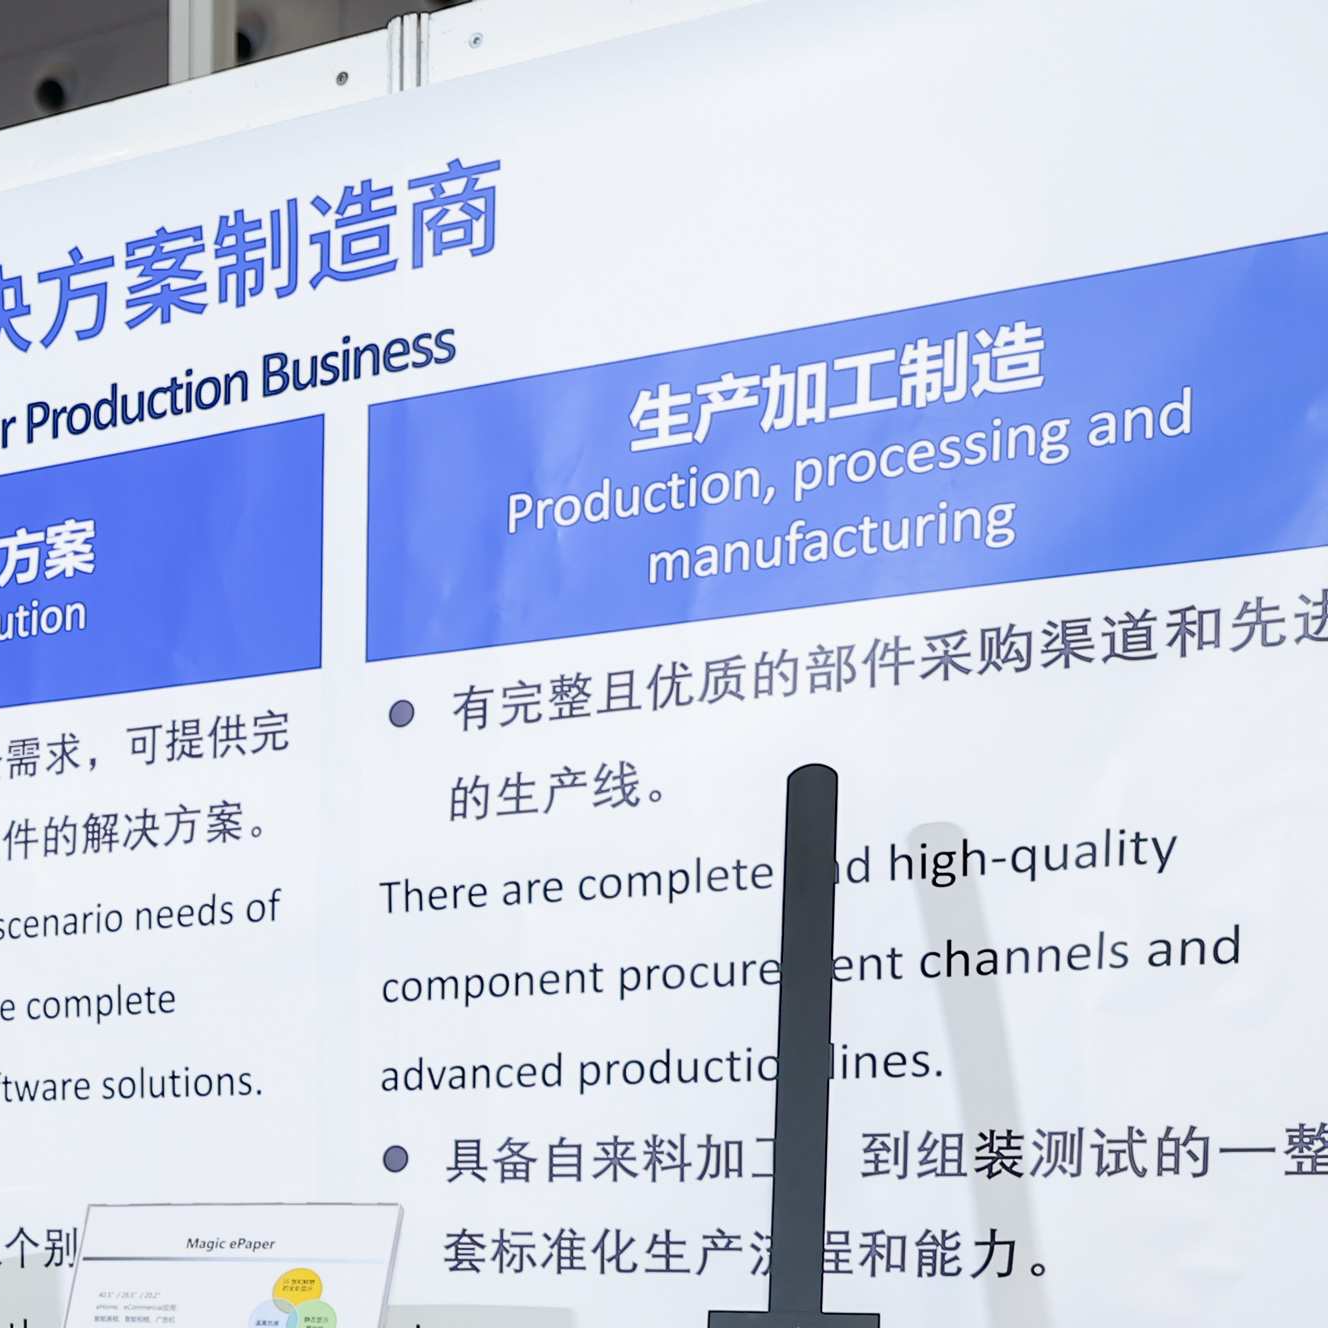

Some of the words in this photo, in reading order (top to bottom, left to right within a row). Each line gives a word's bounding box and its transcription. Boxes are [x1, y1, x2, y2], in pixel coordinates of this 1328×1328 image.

[26, 366, 249, 444] Production
[262, 329, 456, 396] Business
[628, 321, 1044, 452] 生产加工制造
[506, 462, 777, 533] Production,
[793, 412, 1071, 495] processing
[1087, 387, 1193, 446] and
[648, 497, 1016, 583] manufacturing
[449, 760, 667, 821] 的生产线。
[379, 875, 489, 915] There
[502, 871, 565, 908] are
[578, 858, 773, 904] complete
[890, 829, 1178, 887] high-quality
[134, 893, 233, 931] needs
[245, 888, 281, 923] of
[381, 958, 604, 1008] component
[919, 931, 1130, 981] channels
[1146, 925, 1242, 968] and
[26, 984, 175, 1030] complete
[102, 1066, 262, 1100] solutions.
[381, 1051, 563, 1094] advanced
[827, 1042, 942, 1083] lines.
[186, 1238, 226, 1252] Magic
[230, 1238, 275, 1251] ePaper
